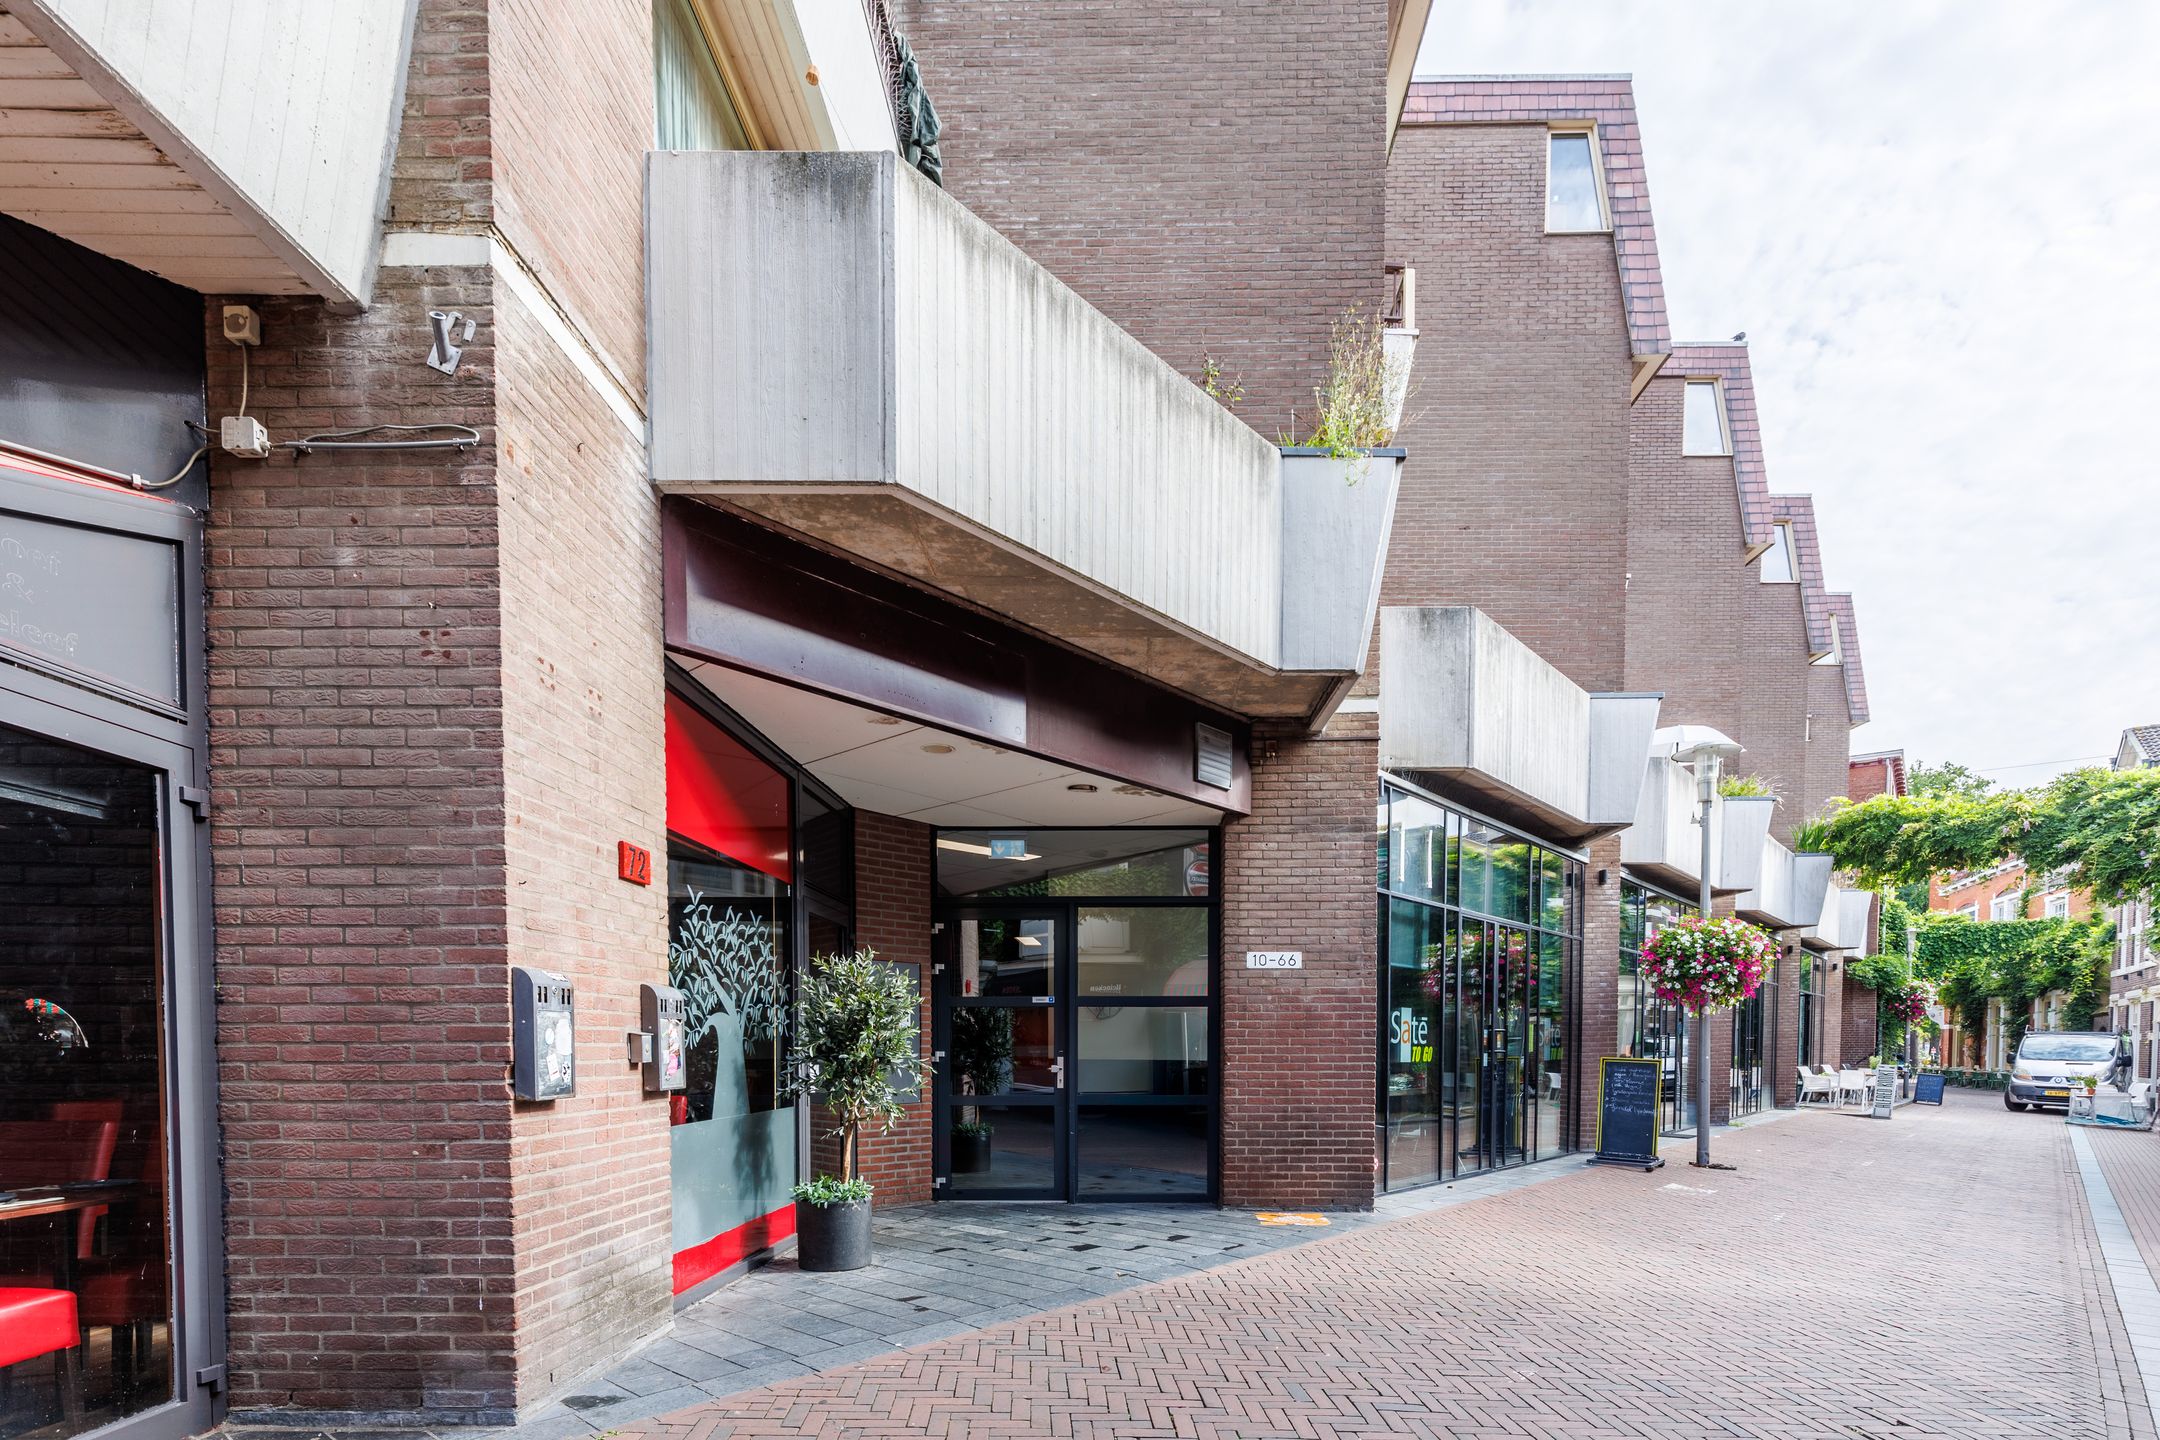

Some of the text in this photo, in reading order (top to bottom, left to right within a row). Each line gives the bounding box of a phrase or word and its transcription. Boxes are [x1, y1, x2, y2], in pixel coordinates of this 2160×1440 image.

[629, 846, 646, 881] 72
[1252, 953, 1297, 967] 10-66
[1411, 1046, 1433, 1063] TO GO
